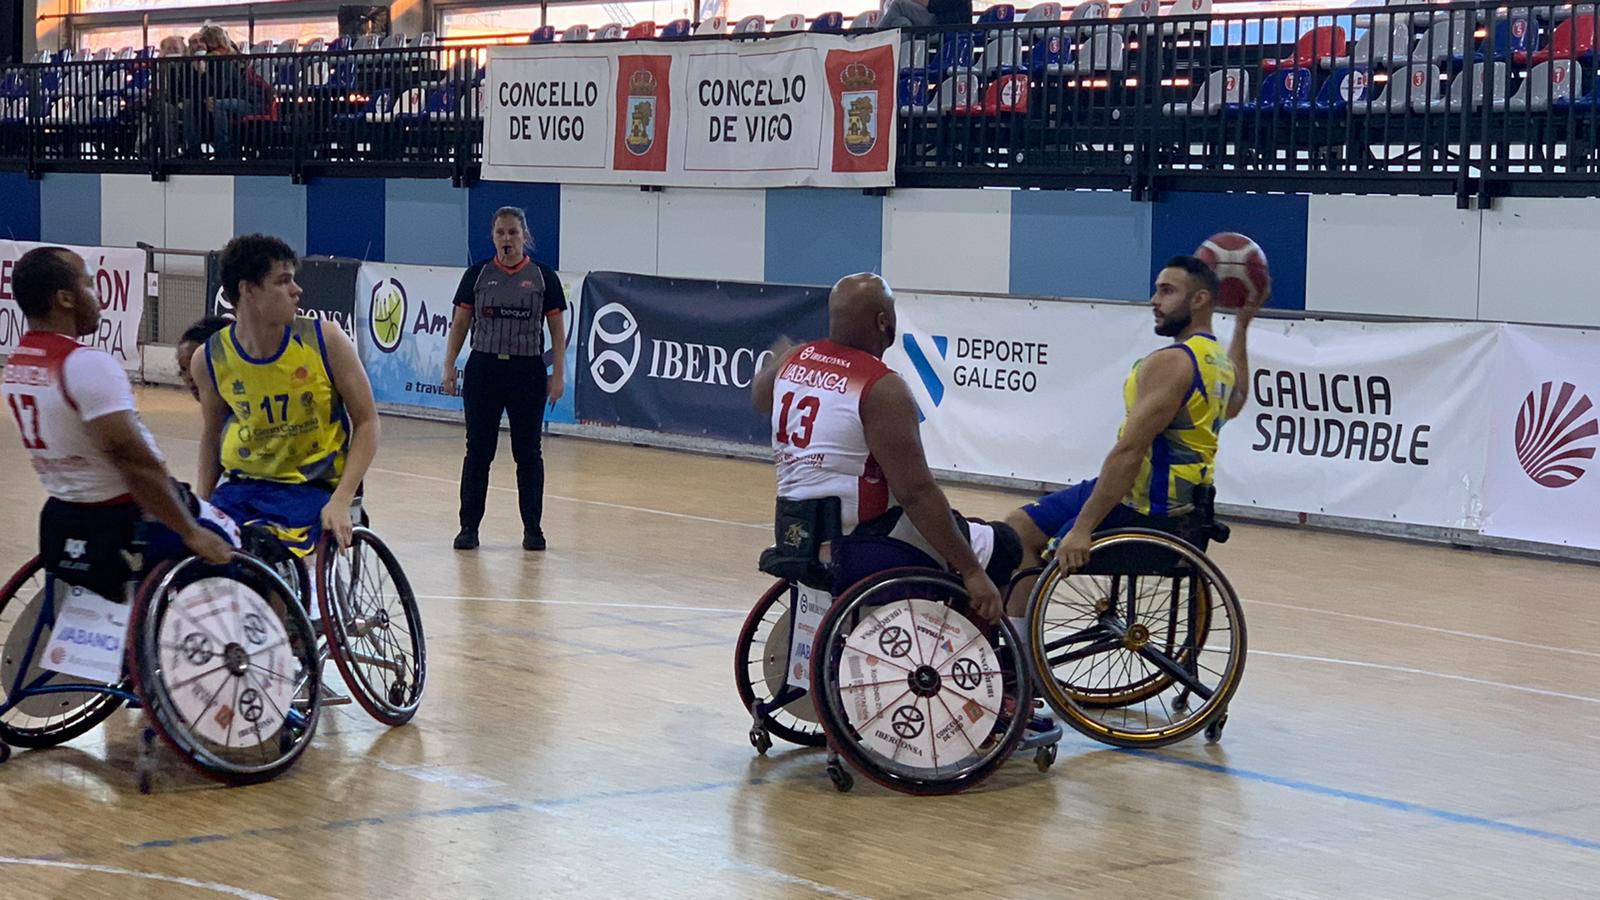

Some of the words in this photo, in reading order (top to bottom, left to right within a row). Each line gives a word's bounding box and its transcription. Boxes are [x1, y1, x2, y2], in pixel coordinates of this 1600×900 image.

[499, 80, 598, 107] CONCELLO
[698, 74, 806, 107] CONCELLO
[509, 115, 531, 140] DE
[538, 115, 585, 141] VIGO
[708, 115, 737, 142] DE
[747, 113, 793, 142] VIGO
[957, 337, 1048, 365] DEPORTE
[405, 381, 413, 391] a
[415, 381, 448, 396] travé
[784, 363, 848, 393] ABANCA
[953, 365, 1037, 392] GALEGO
[1253, 368, 1392, 415] GALICIA
[8, 393, 48, 449] 17
[260, 393, 289, 424] 17
[776, 391, 820, 449] 13
[1252, 413, 1431, 465] SAUDABLE
